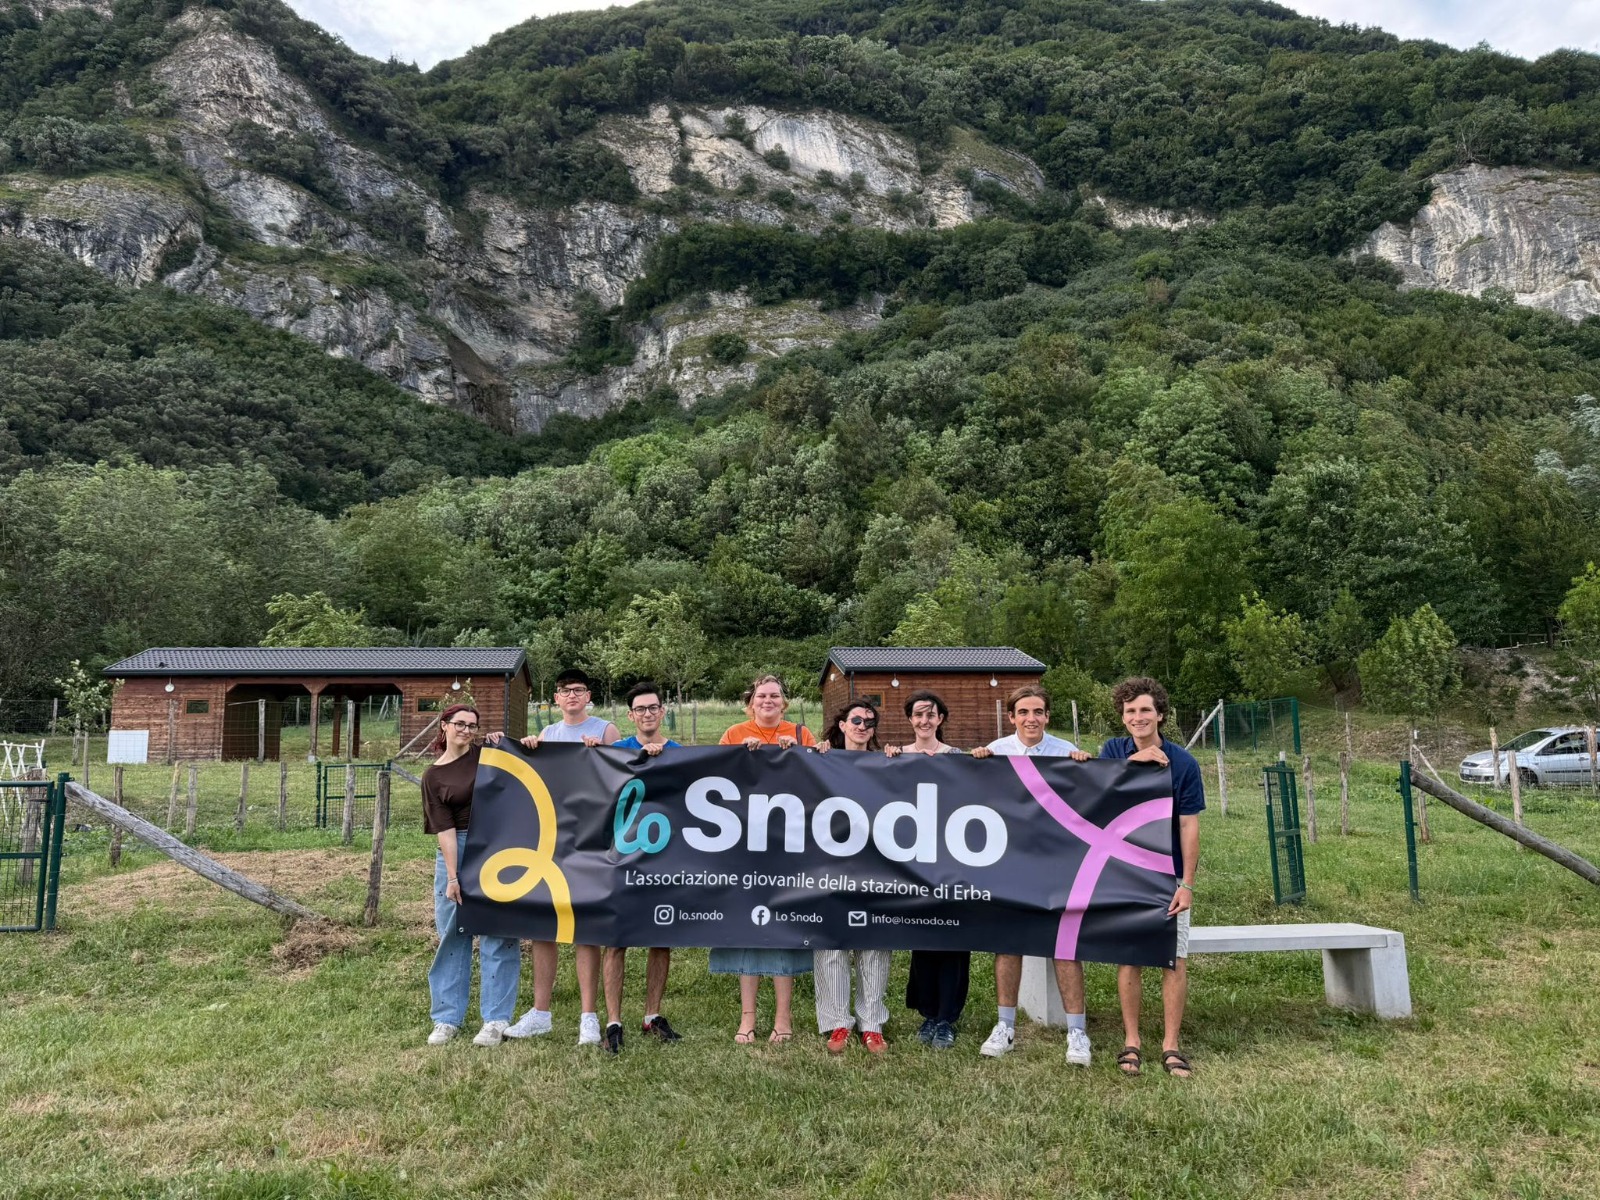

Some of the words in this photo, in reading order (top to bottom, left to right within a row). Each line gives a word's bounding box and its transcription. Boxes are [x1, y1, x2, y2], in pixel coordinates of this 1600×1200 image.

[613, 778, 671, 855] lo
[682, 776, 1009, 868] Snodo
[624, 870, 738, 886] L'associazione
[742, 870, 815, 889] giovanile
[818, 873, 857, 892] della
[860, 878, 930, 898] stazione
[933, 882, 949, 900] di
[953, 884, 992, 901] Erba
[678, 909, 724, 921] lo.snodo
[775, 911, 788, 922] Lo
[790, 911, 823, 923] Snodo
[871, 913, 960, 927] info@losnodo.eu
